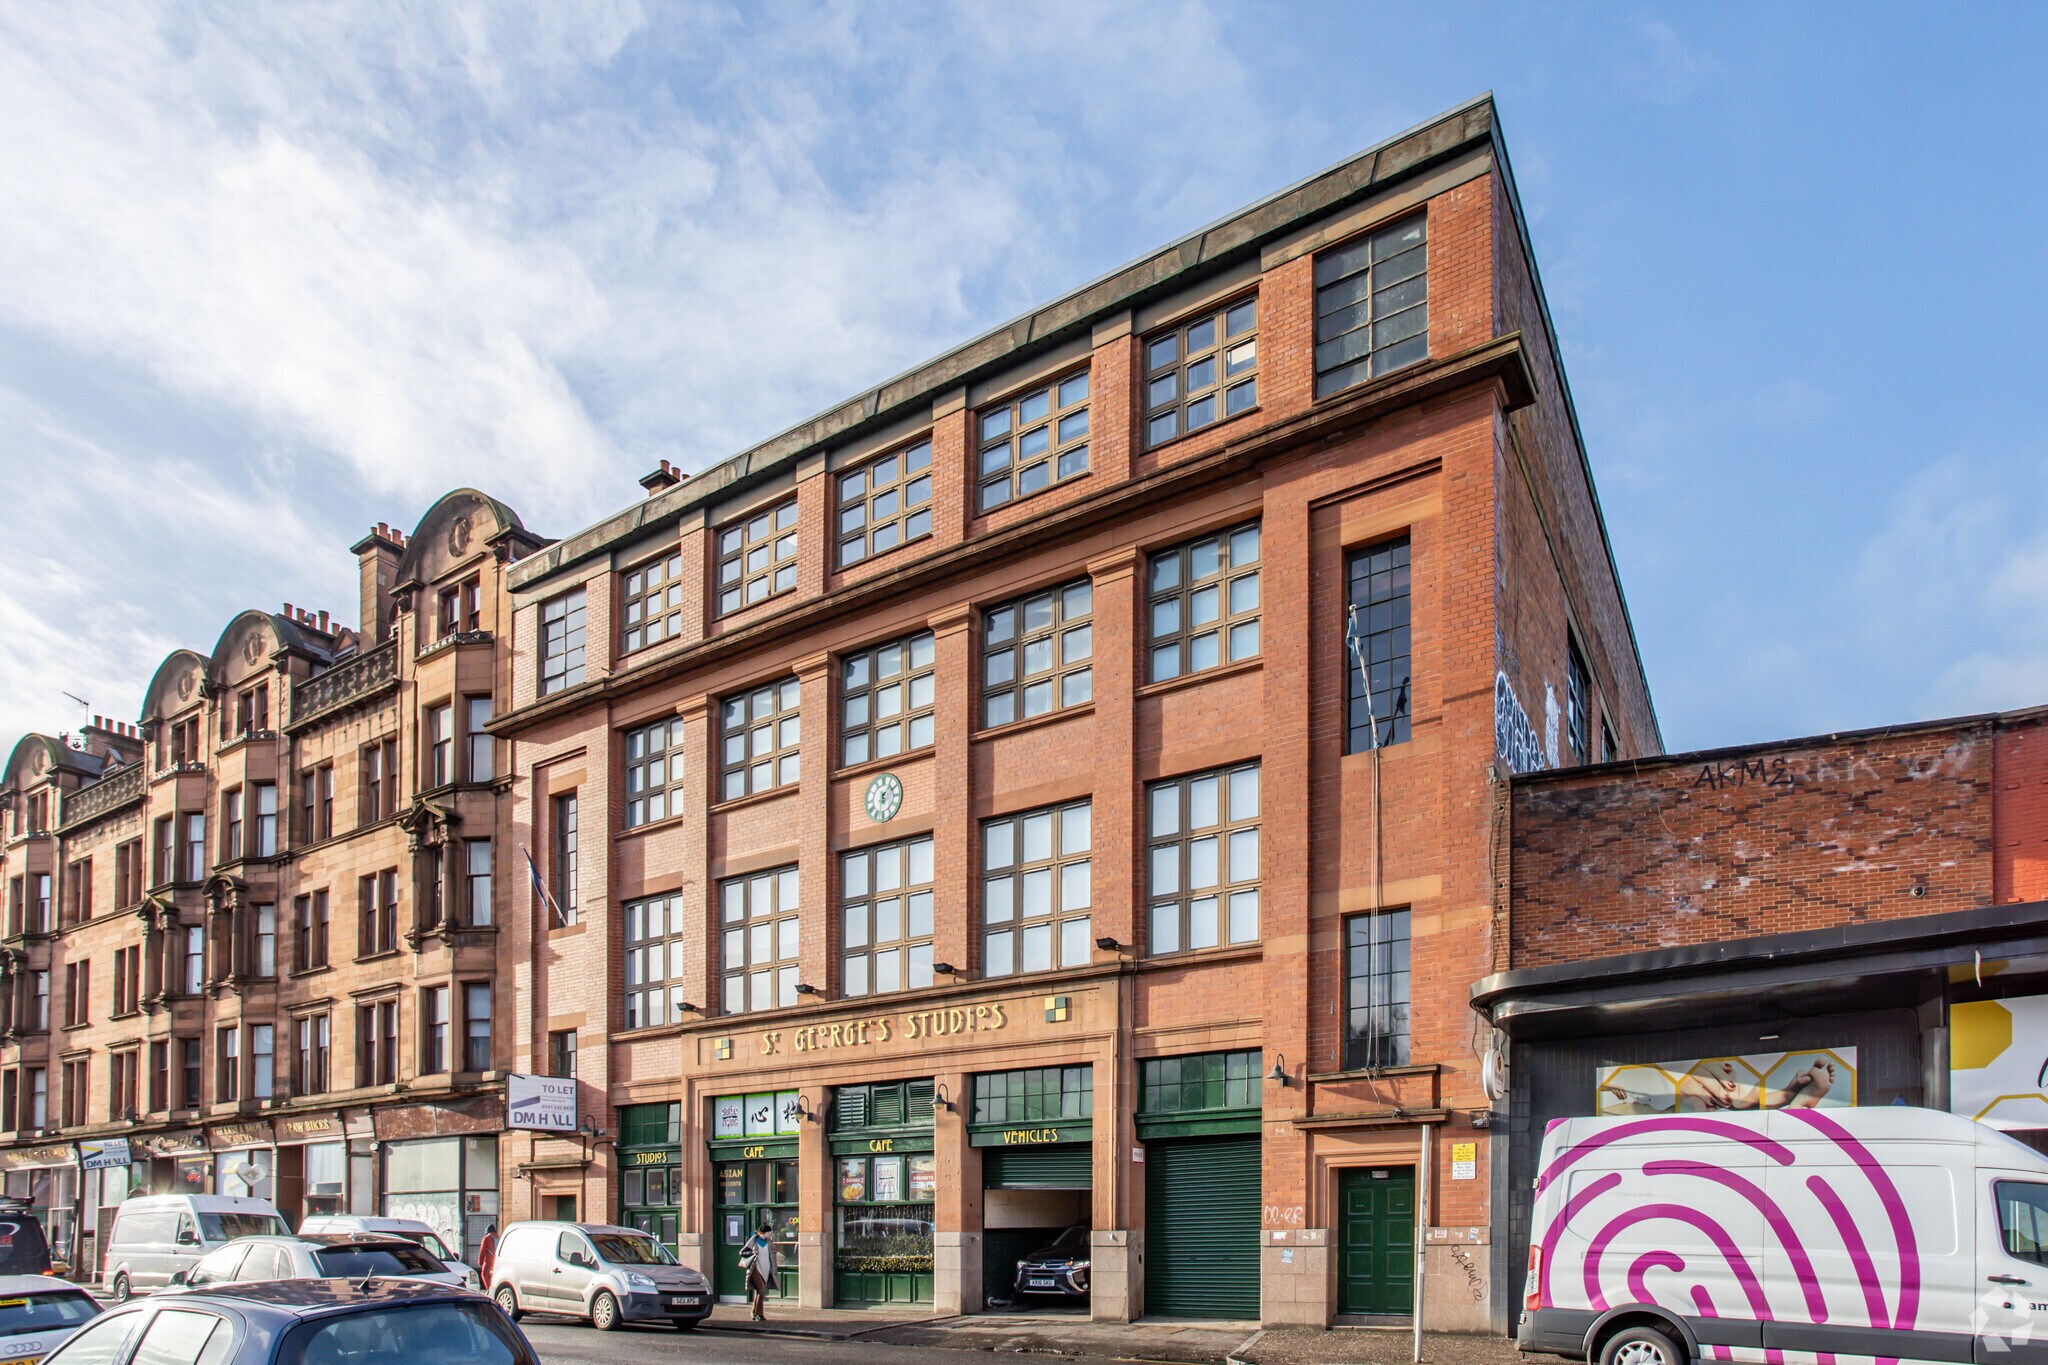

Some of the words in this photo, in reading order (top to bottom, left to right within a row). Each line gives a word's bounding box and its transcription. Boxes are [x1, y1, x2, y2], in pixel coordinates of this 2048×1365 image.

[794, 1018, 890, 1051] GEORGE'S
[904, 1004, 1005, 1038] STUDIOS
[542, 1085, 555, 1093] TO
[557, 1086, 574, 1094] LET
[514, 1111, 535, 1124] DM
[282, 1121, 304, 1134] BRAW
[304, 1119, 330, 1132] BIKES
[1003, 1128, 1058, 1144] VEHICLES
[86, 1159, 102, 1168] DM
[636, 1152, 667, 1164] STUDIOS
[719, 1168, 743, 1178] ASIAN
